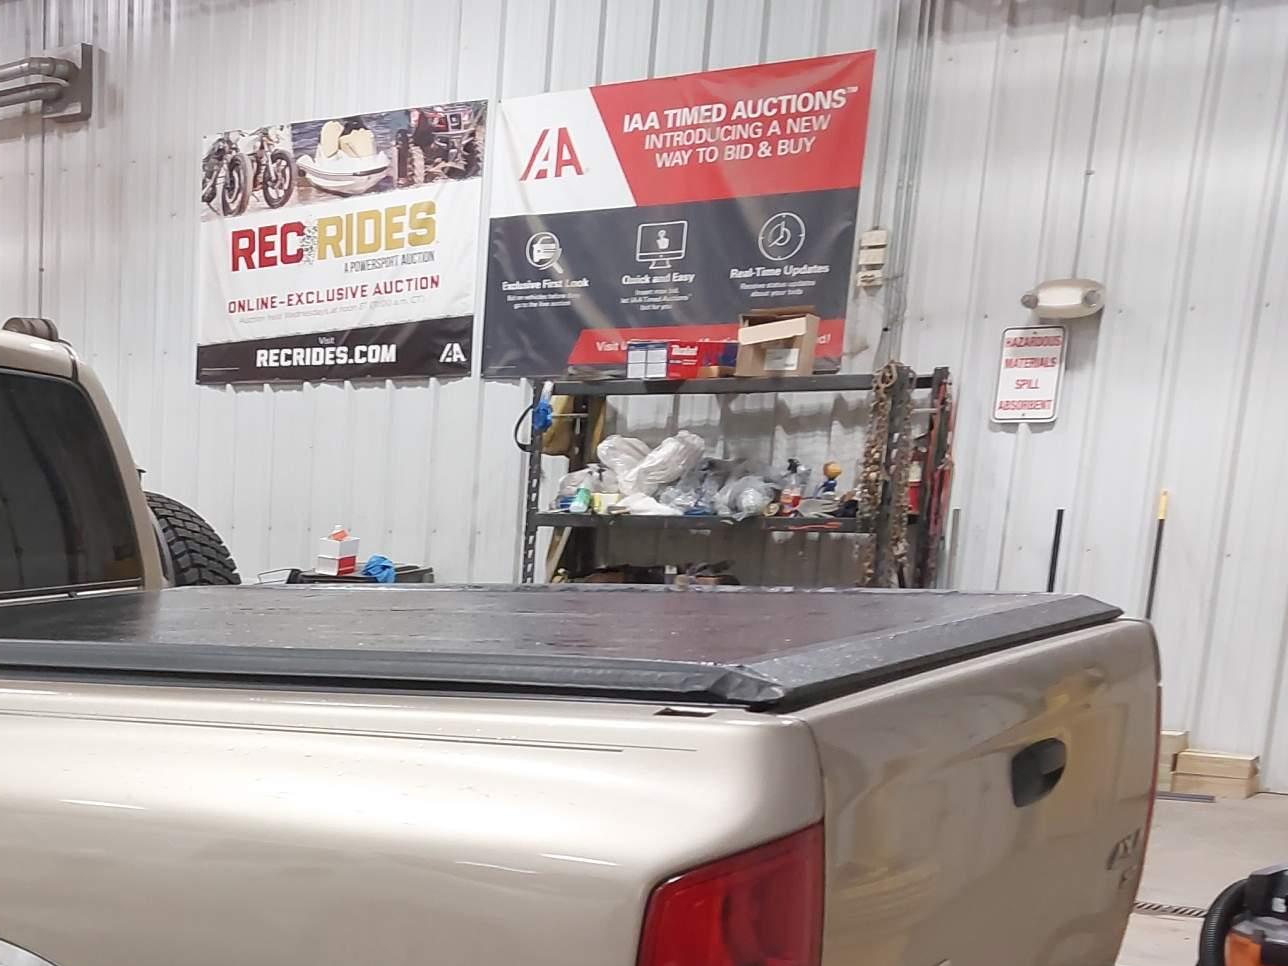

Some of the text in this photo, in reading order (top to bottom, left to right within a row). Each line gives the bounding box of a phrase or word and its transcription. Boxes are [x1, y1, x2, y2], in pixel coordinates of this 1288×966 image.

[623, 111, 660, 133] IAA
[663, 104, 727, 130] TIMED
[644, 114, 831, 150] INTRODUCING A NEW
[655, 136, 816, 168] WAY TO BID & BUY
[231, 200, 438, 272] REC RIDES
[350, 256, 401, 274] POWERSPORT
[401, 250, 436, 267] AUCTION
[729, 264, 830, 279] Real-Time Updates
[502, 280, 542, 291] Exclusive
[565, 277, 590, 288] Look
[622, 271, 696, 285] Quick and Easy
[228, 284, 368, 314] ONLINE-EXCLUSIVE
[373, 275, 441, 297] AUCTION
[255, 344, 398, 368] RECRIDES.COM
[596, 341, 619, 352] Visit
[1004, 356, 1057, 369] MATERIALS
[1014, 378, 1040, 390] SPILL
